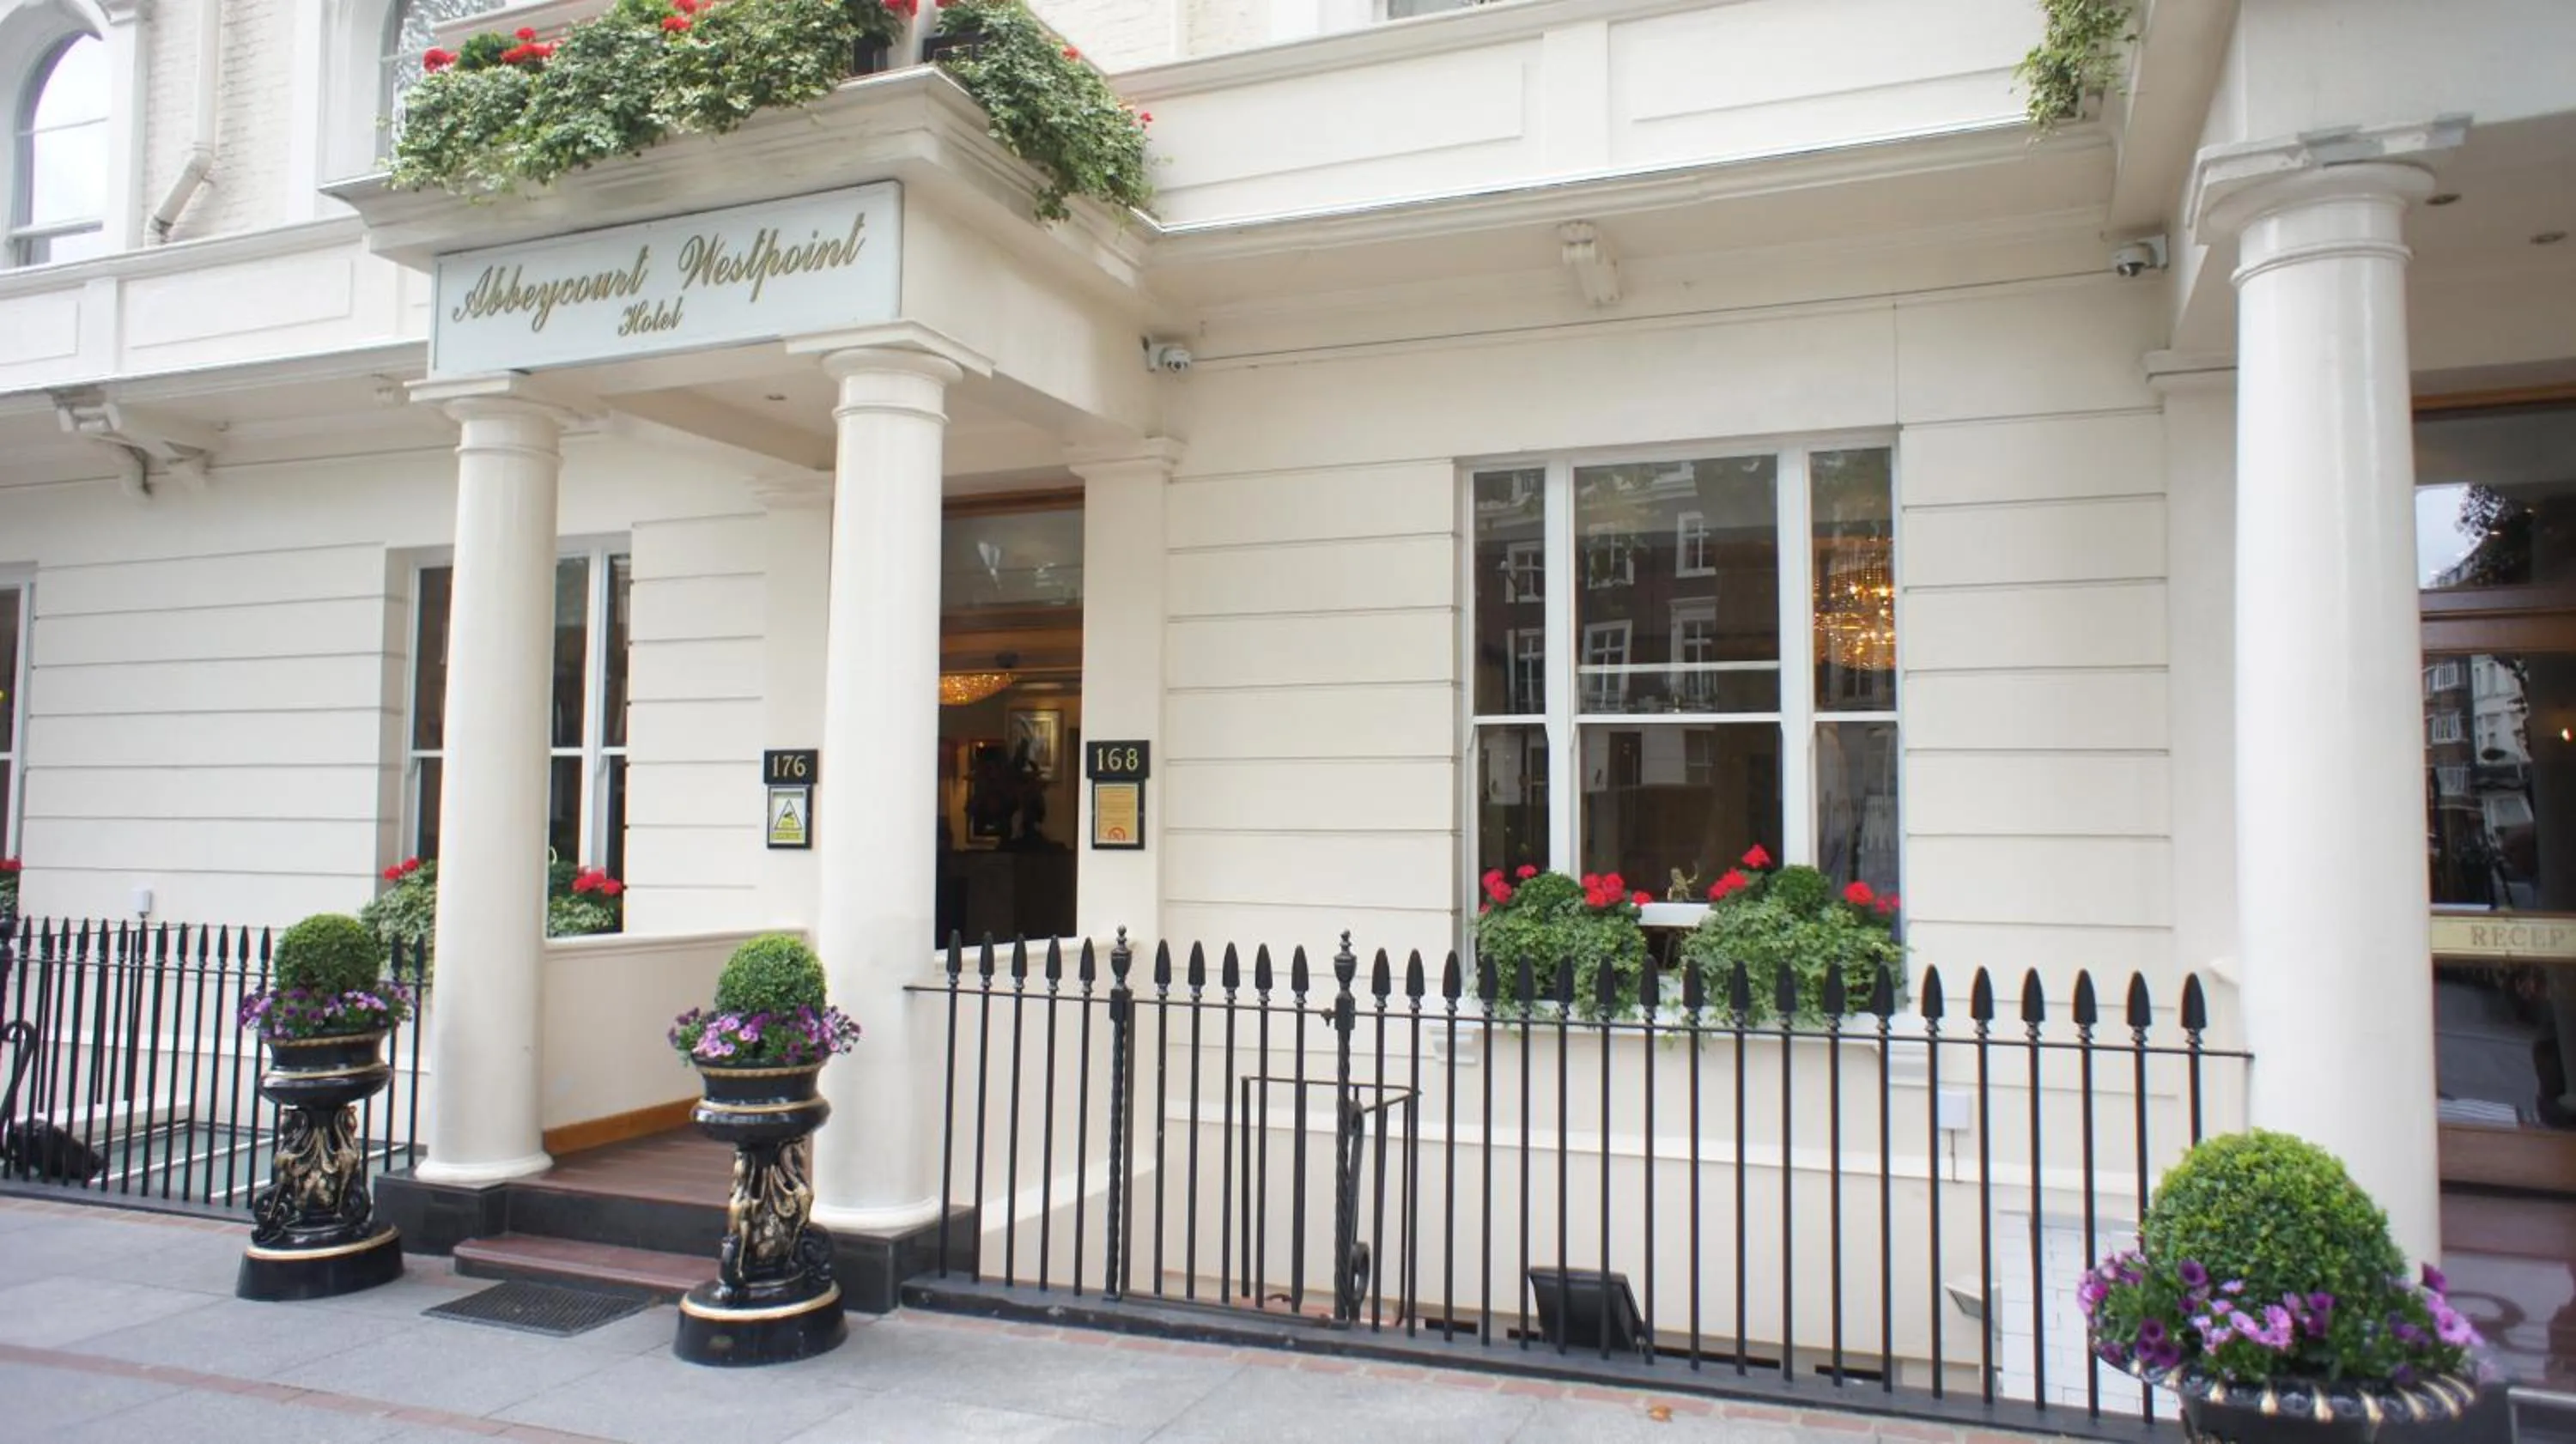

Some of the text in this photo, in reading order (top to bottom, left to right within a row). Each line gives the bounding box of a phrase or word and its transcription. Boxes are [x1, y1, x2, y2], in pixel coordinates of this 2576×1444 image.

[453, 212, 866, 332] Abbeycourt Westpoint
[617, 296, 683, 337] Hotel
[772, 755, 807, 777] 176
[1096, 748, 1139, 771] 168
[2470, 924, 2576, 949] RECEP
